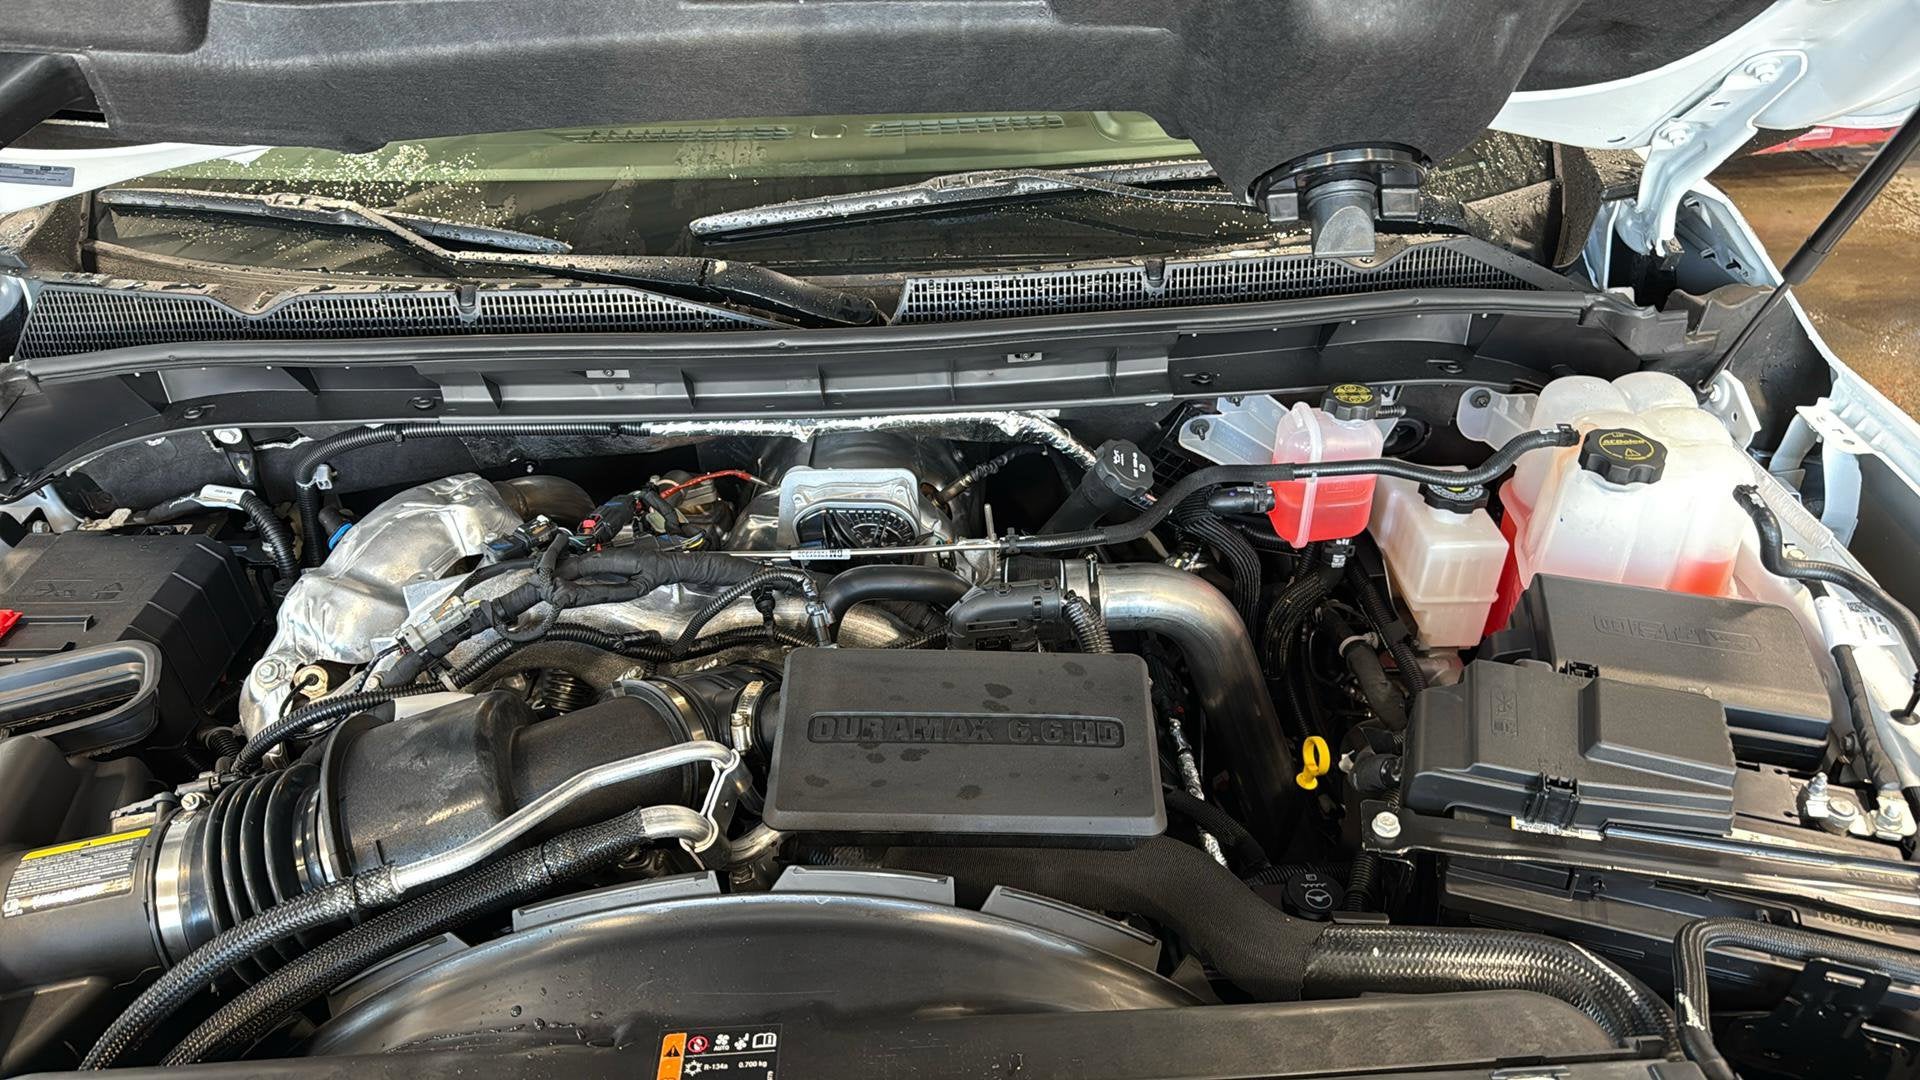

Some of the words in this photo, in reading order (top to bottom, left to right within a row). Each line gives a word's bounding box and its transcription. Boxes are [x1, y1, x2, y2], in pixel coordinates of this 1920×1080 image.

[812, 717, 993, 741] DURAMAX
[1008, 719, 1064, 743] 6.6
[1072, 720, 1121, 745] HD
[703, 1062, 728, 1071] R-134a
[738, 1060, 758, 1069] 0.700
[758, 1060, 768, 1069] kg
